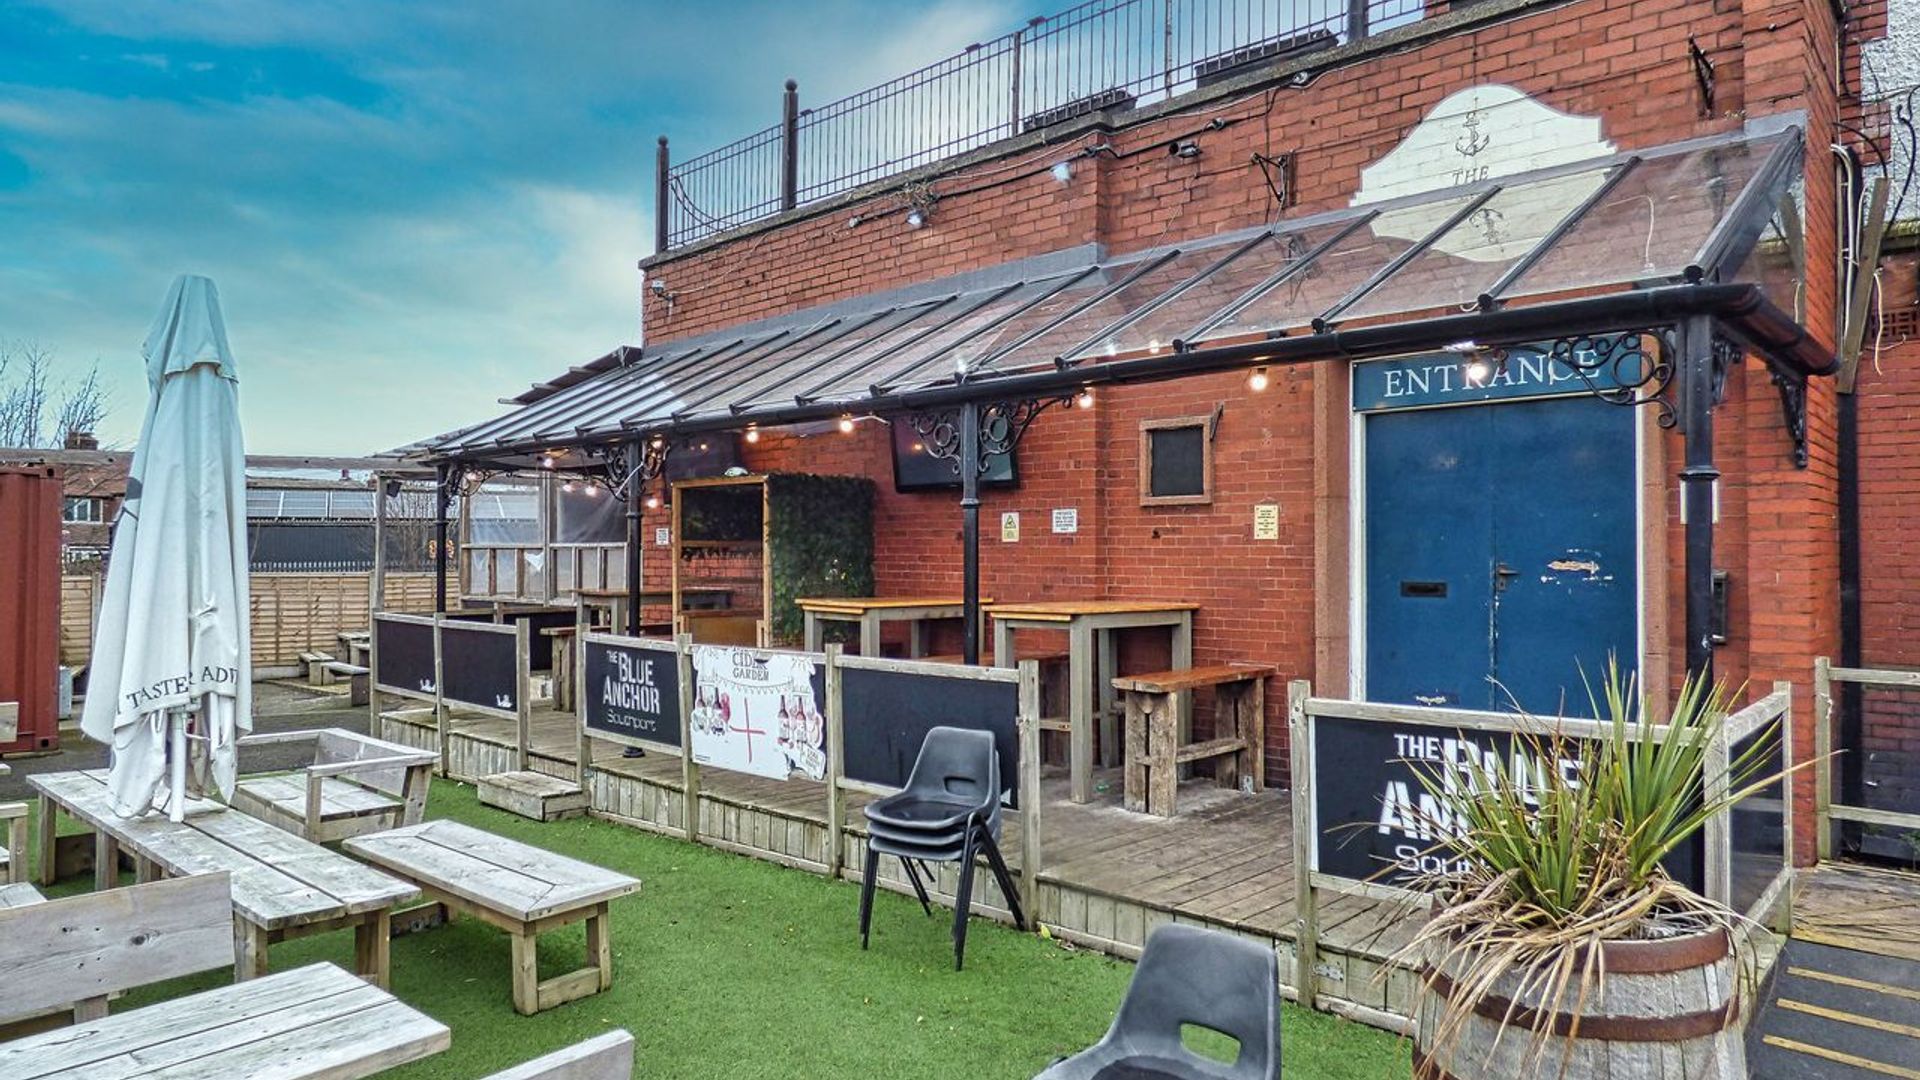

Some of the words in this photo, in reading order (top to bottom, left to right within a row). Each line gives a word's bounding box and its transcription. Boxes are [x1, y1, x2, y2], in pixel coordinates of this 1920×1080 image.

[1383, 350, 1600, 398] ENTRANCE
[606, 650, 618, 664] THE
[618, 652, 654, 687] BLUE
[732, 667, 770, 681] GARDEN
[602, 675, 660, 714] ANCHOR
[606, 708, 656, 732] Southport
[1394, 734, 1440, 759] THE
